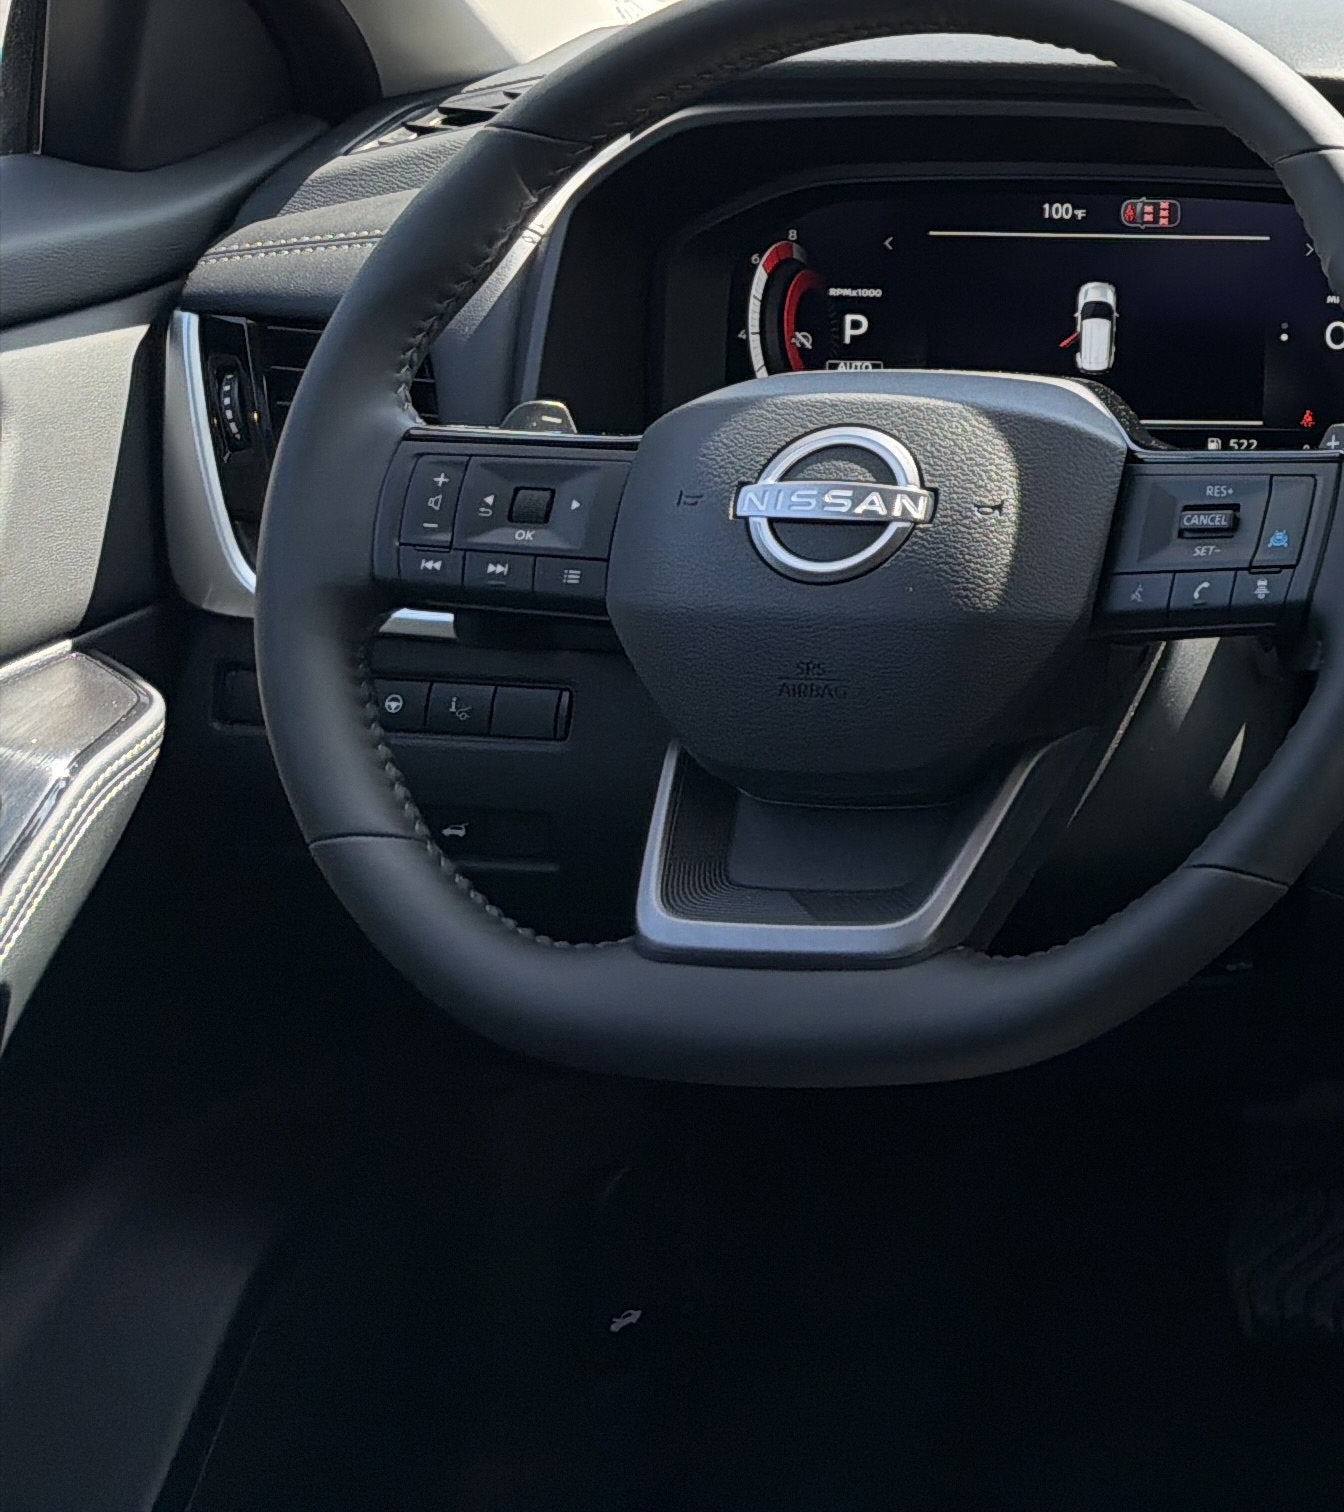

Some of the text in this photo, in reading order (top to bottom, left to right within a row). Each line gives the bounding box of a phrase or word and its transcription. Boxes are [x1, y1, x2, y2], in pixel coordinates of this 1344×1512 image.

[788, 229, 797, 240] 8
[751, 254, 760, 265] 6
[843, 313, 868, 344] P
[838, 362, 872, 370] AUTO
[1229, 439, 1258, 450] 522
[1206, 485, 1234, 497] RES+
[742, 489, 929, 520] NISSAN
[1183, 514, 1228, 526] CANCEL
[515, 530, 536, 540] OK
[795, 661, 826, 676] SRS
[778, 682, 849, 699] AIRBAG
